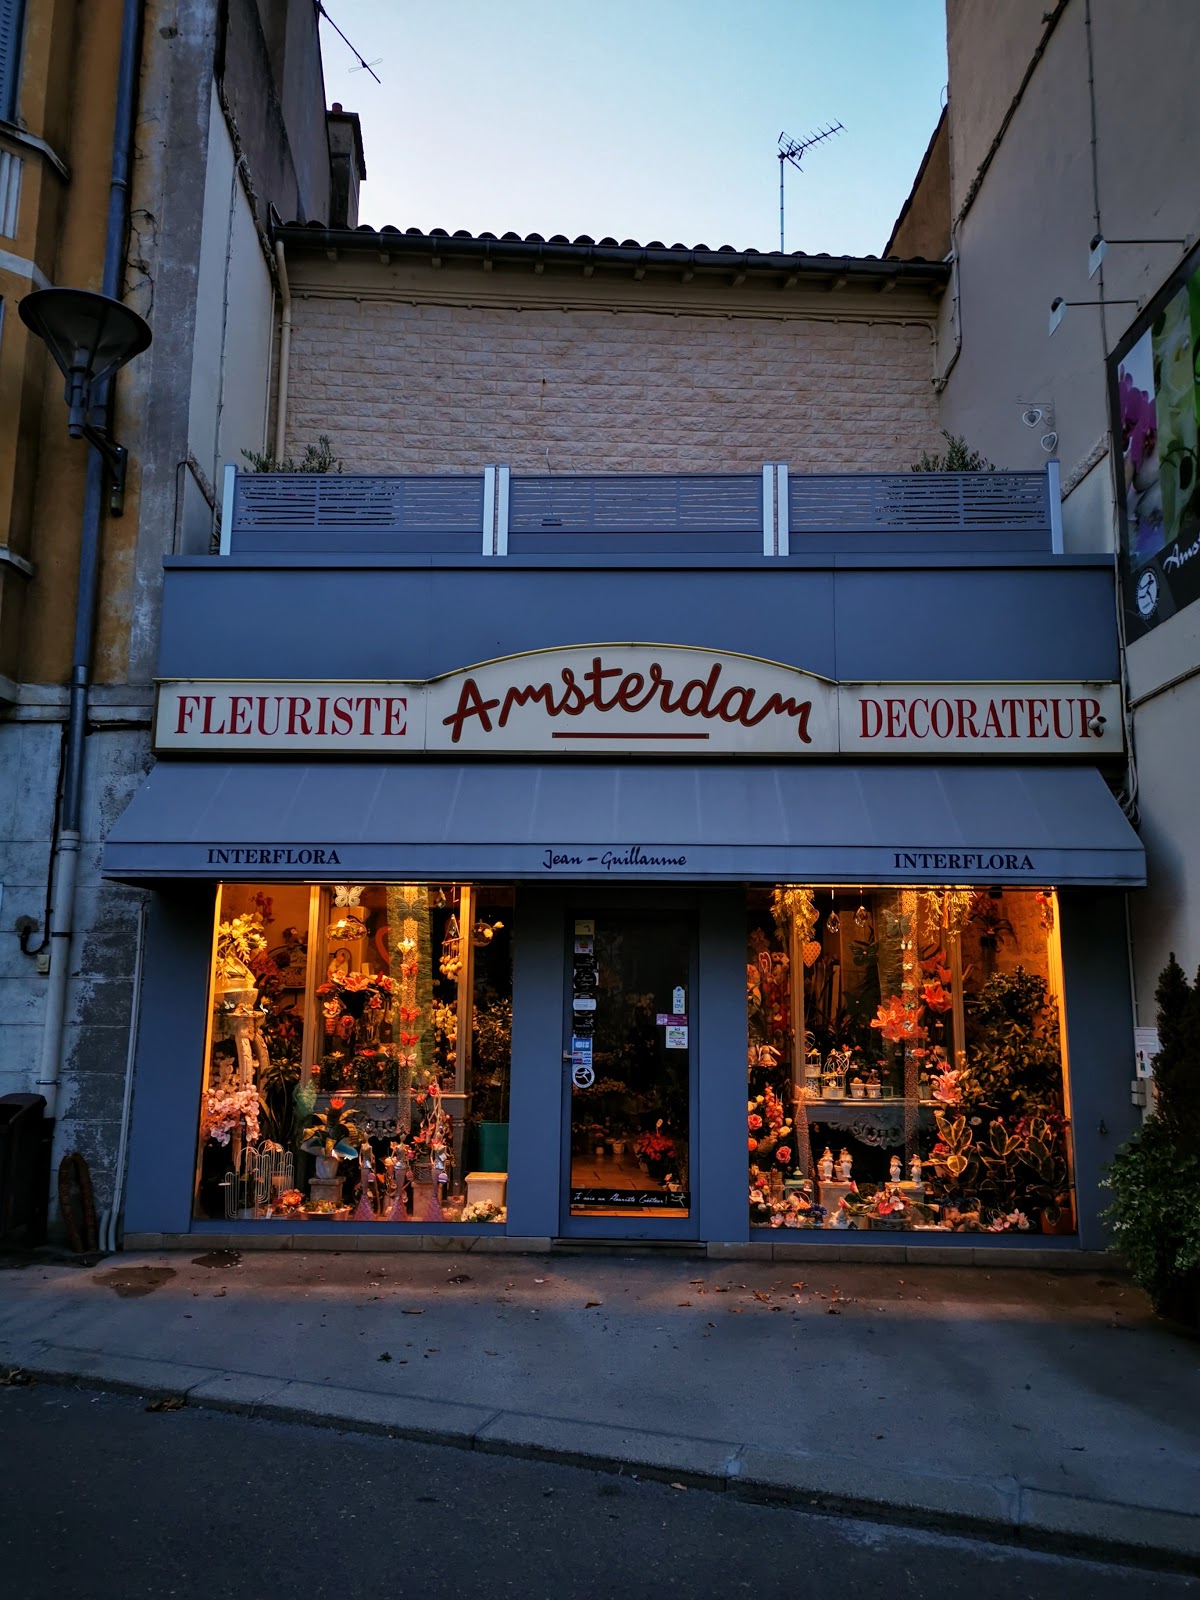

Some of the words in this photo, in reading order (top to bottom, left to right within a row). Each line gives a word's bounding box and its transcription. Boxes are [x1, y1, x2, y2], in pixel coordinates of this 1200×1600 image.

[175, 696, 407, 736] FLEURISTE
[443, 657, 813, 744] Amsterdam
[860, 699, 1104, 738] DECORATEUR
[207, 849, 341, 864] INTERFLORA
[894, 853, 1035, 870] INTERFLORA
